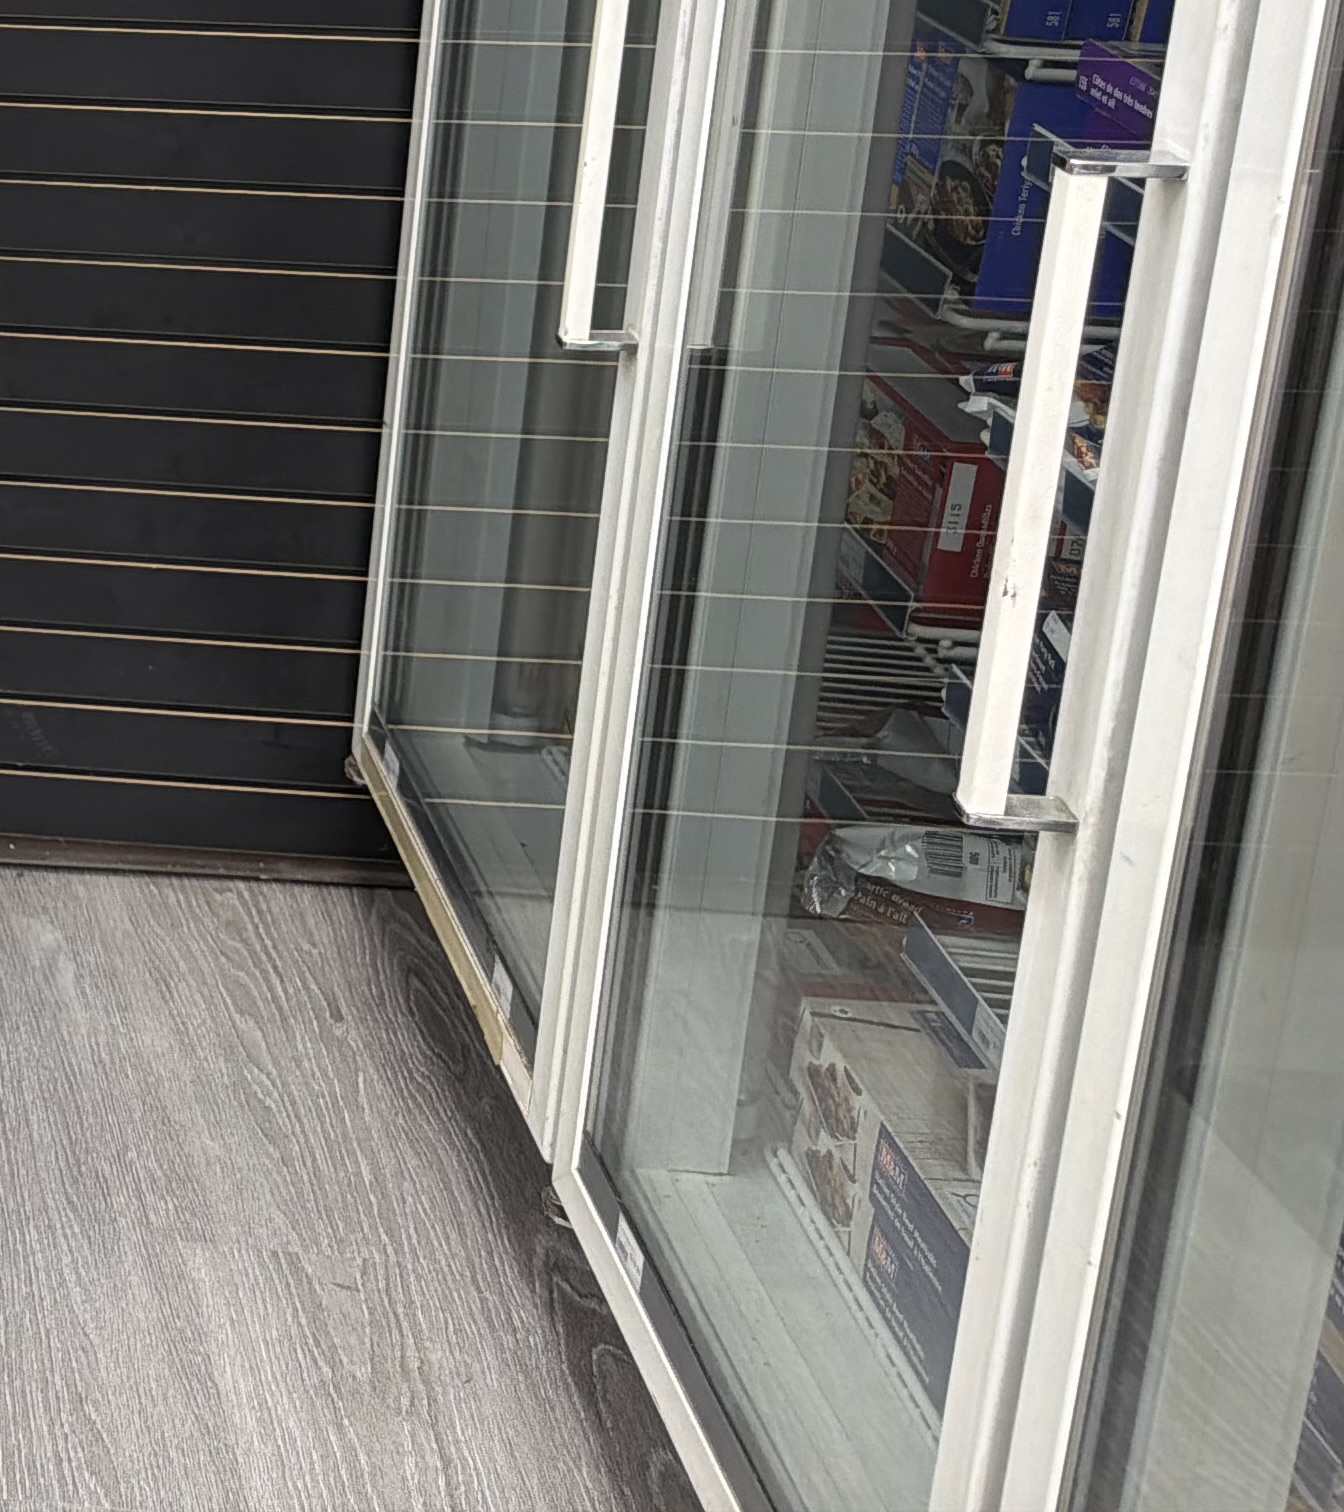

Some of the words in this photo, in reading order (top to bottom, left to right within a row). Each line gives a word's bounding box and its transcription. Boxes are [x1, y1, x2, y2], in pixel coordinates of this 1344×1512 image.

[1045, 10, 1062, 28] 581
[1011, 195, 1026, 237] Chicken
[970, 548, 984, 579] Chicken
